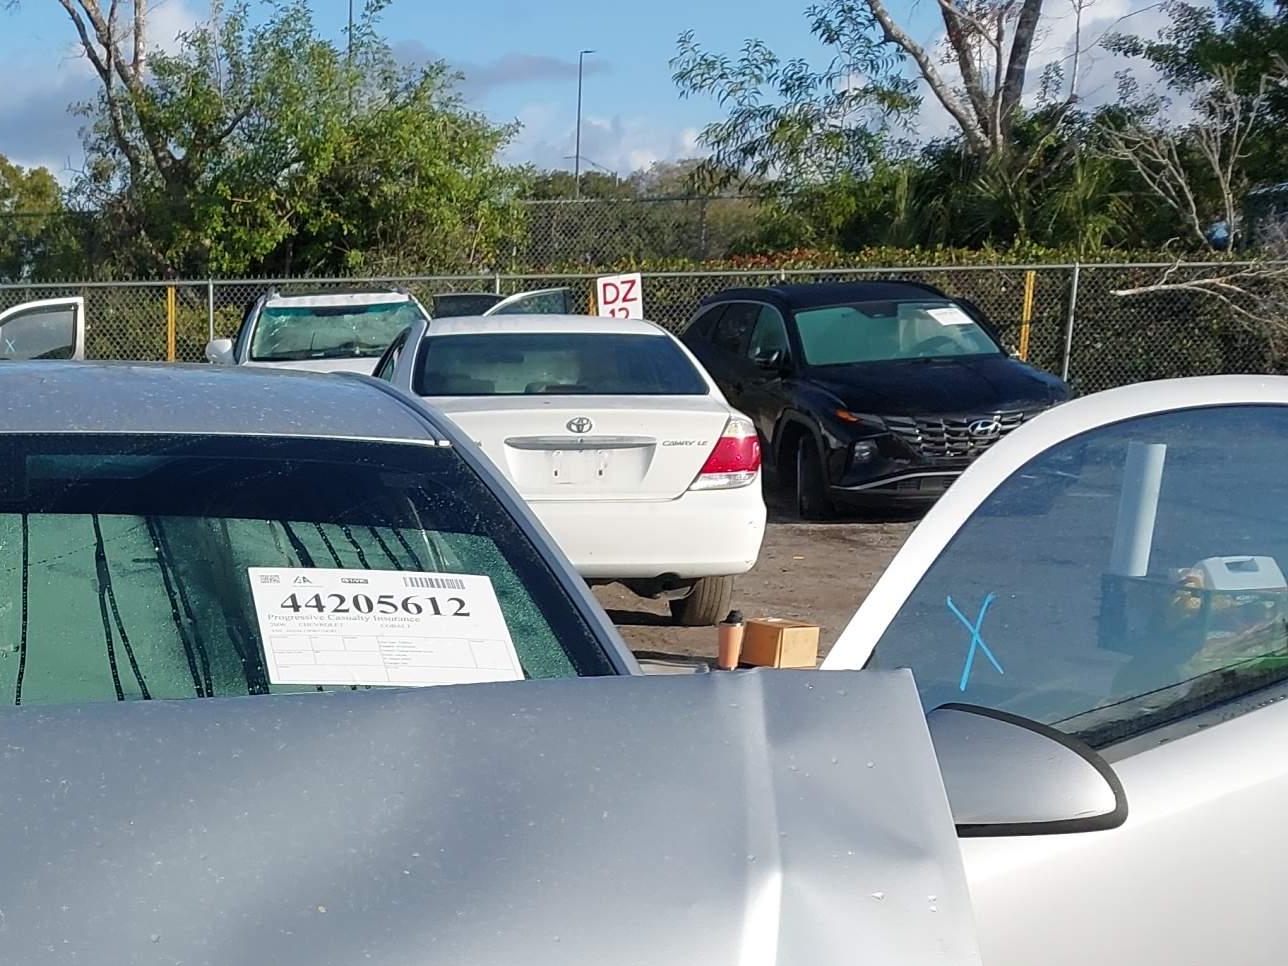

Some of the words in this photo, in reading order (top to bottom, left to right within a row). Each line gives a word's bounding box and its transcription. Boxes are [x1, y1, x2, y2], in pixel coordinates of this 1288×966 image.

[602, 279, 638, 305] DZ
[280, 592, 470, 617] 44205612
[327, 614, 370, 622] Casualty
